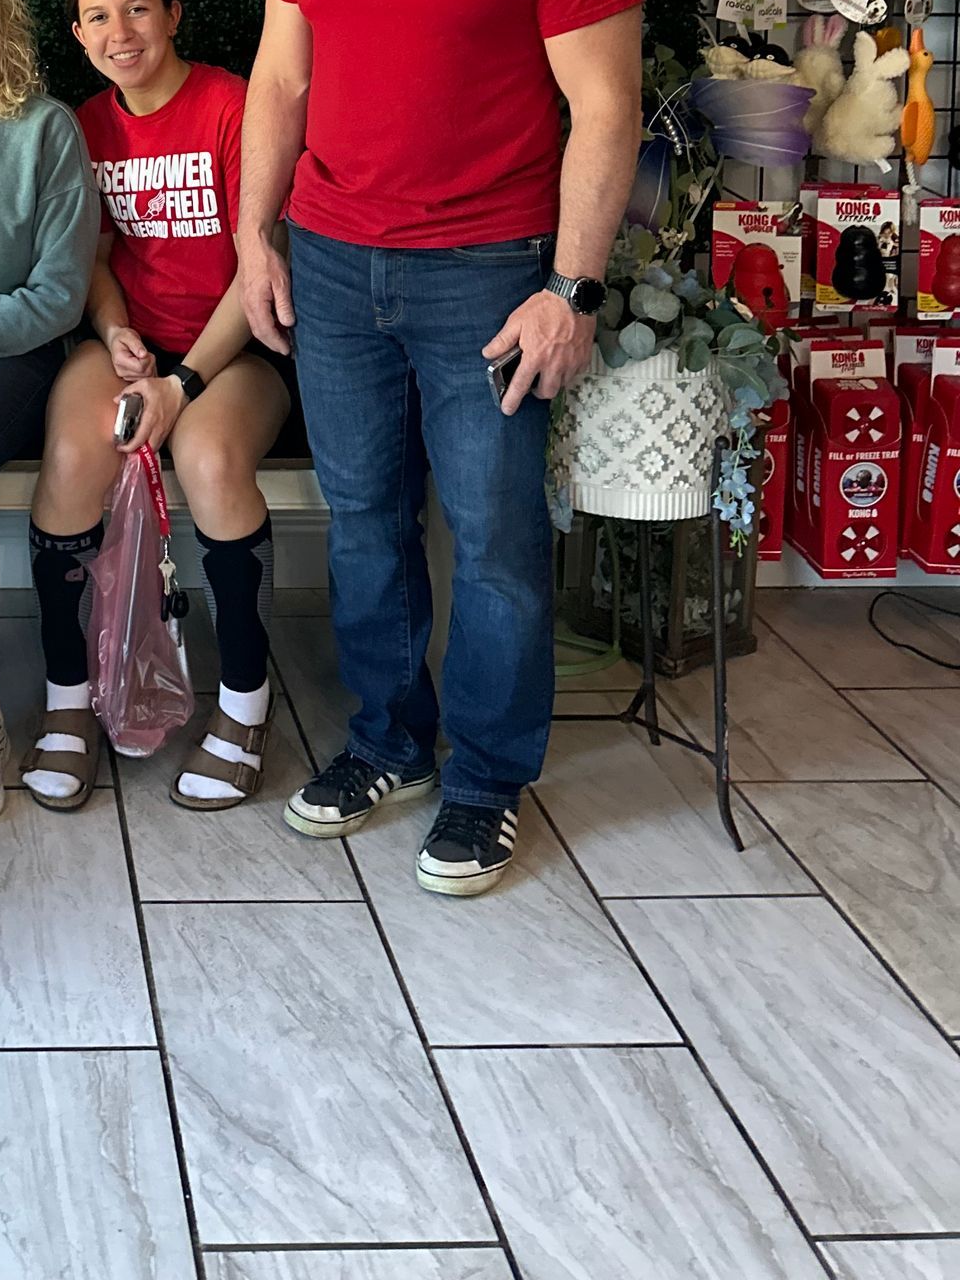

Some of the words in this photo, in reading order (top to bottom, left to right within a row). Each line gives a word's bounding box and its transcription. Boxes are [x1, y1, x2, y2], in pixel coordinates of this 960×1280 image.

[725, 0, 754, 12] rascal
[104, 193, 141, 221] ACK
[165, 188, 218, 219] FIELD
[836, 202, 870, 216] KONG
[738, 214, 769, 226] KONG
[838, 215, 877, 223] EXTREME
[132, 220, 169, 239] RECORD
[172, 217, 222, 238] HOLDER
[831, 352, 857, 364] KONG
[769, 434, 787, 442] TRAY
[828, 452, 844, 460] FILL
[855, 451, 880, 460] FREEZE
[881, 450, 899, 459] TRAY
[848, 509, 871, 518] KONG
